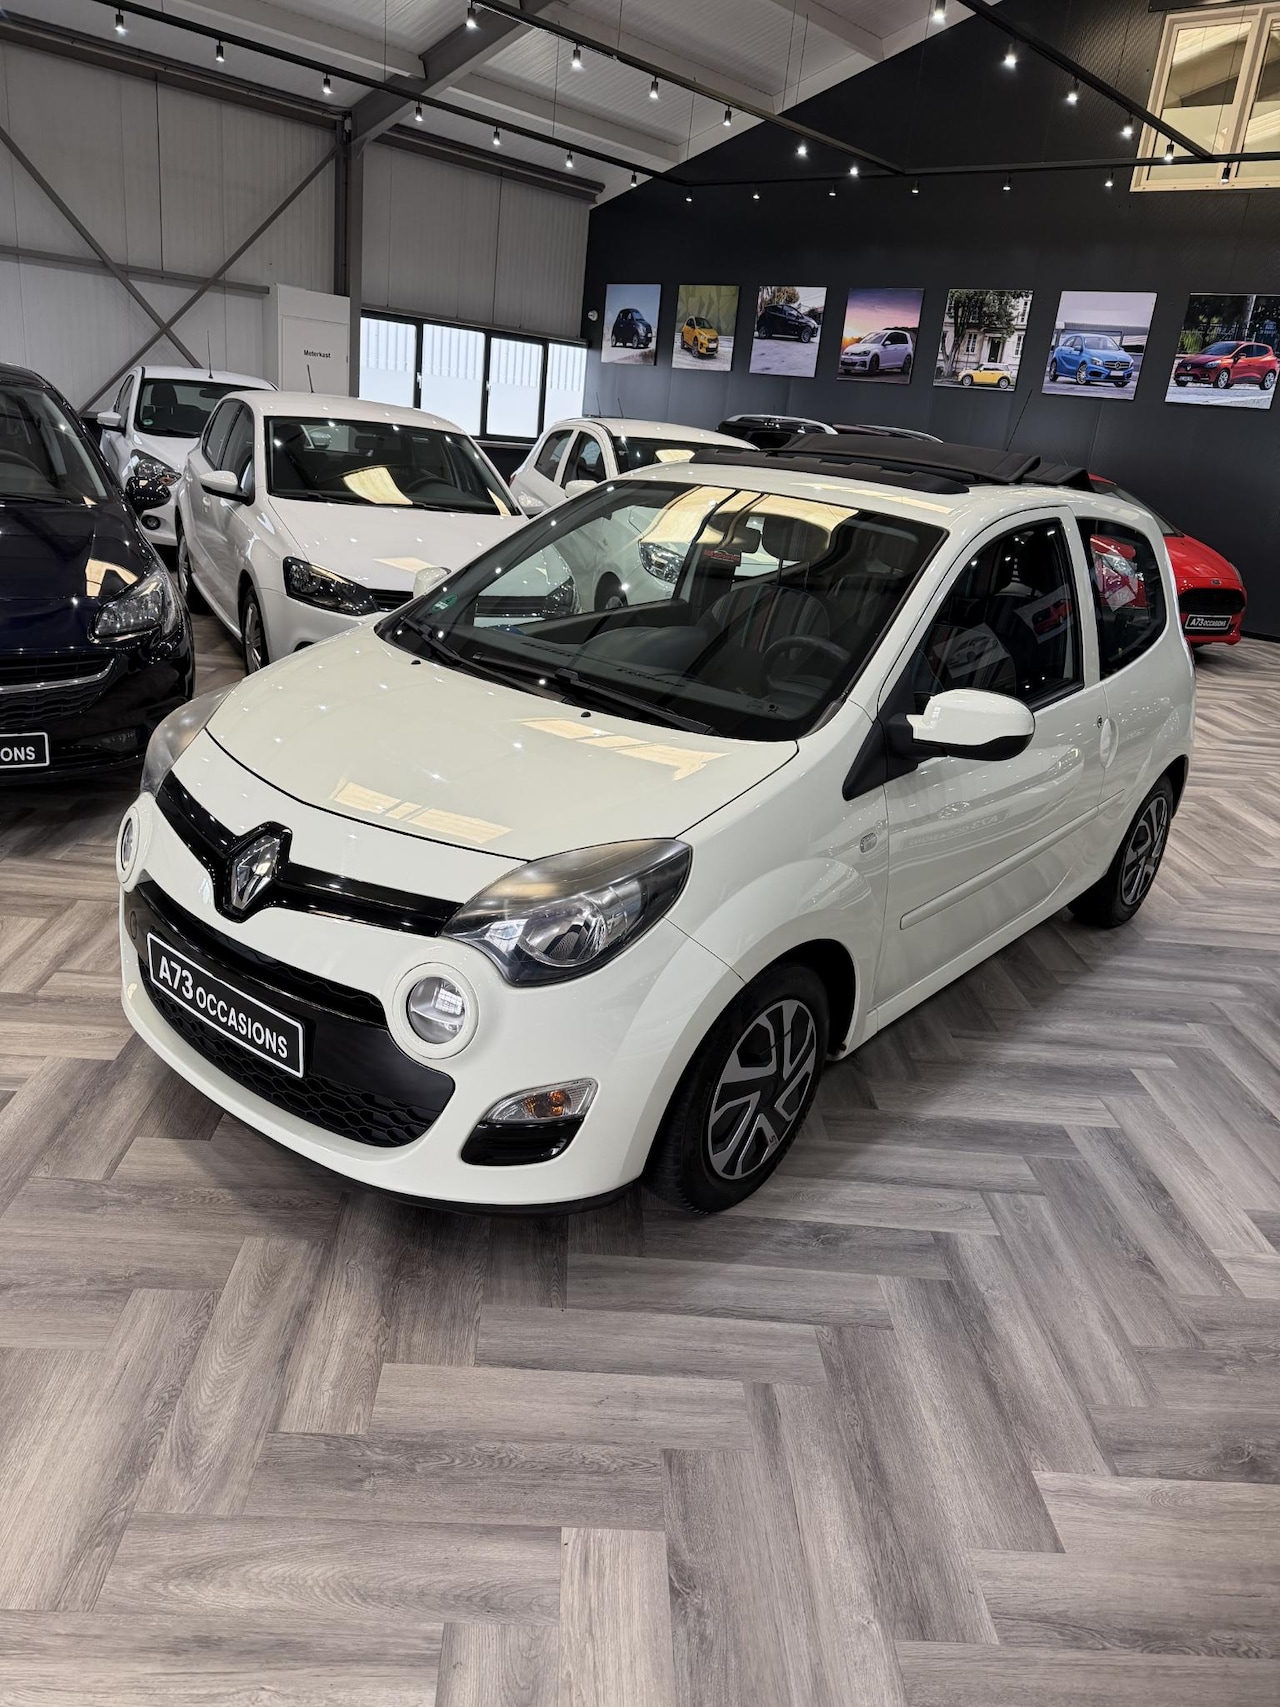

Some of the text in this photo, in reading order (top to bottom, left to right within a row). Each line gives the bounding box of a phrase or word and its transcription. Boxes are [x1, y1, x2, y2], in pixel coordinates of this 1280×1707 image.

[303, 349, 331, 359] Meterkast
[1190, 617, 1204, 626] A73
[159, 955, 288, 1059] A73 OCCASIONS
